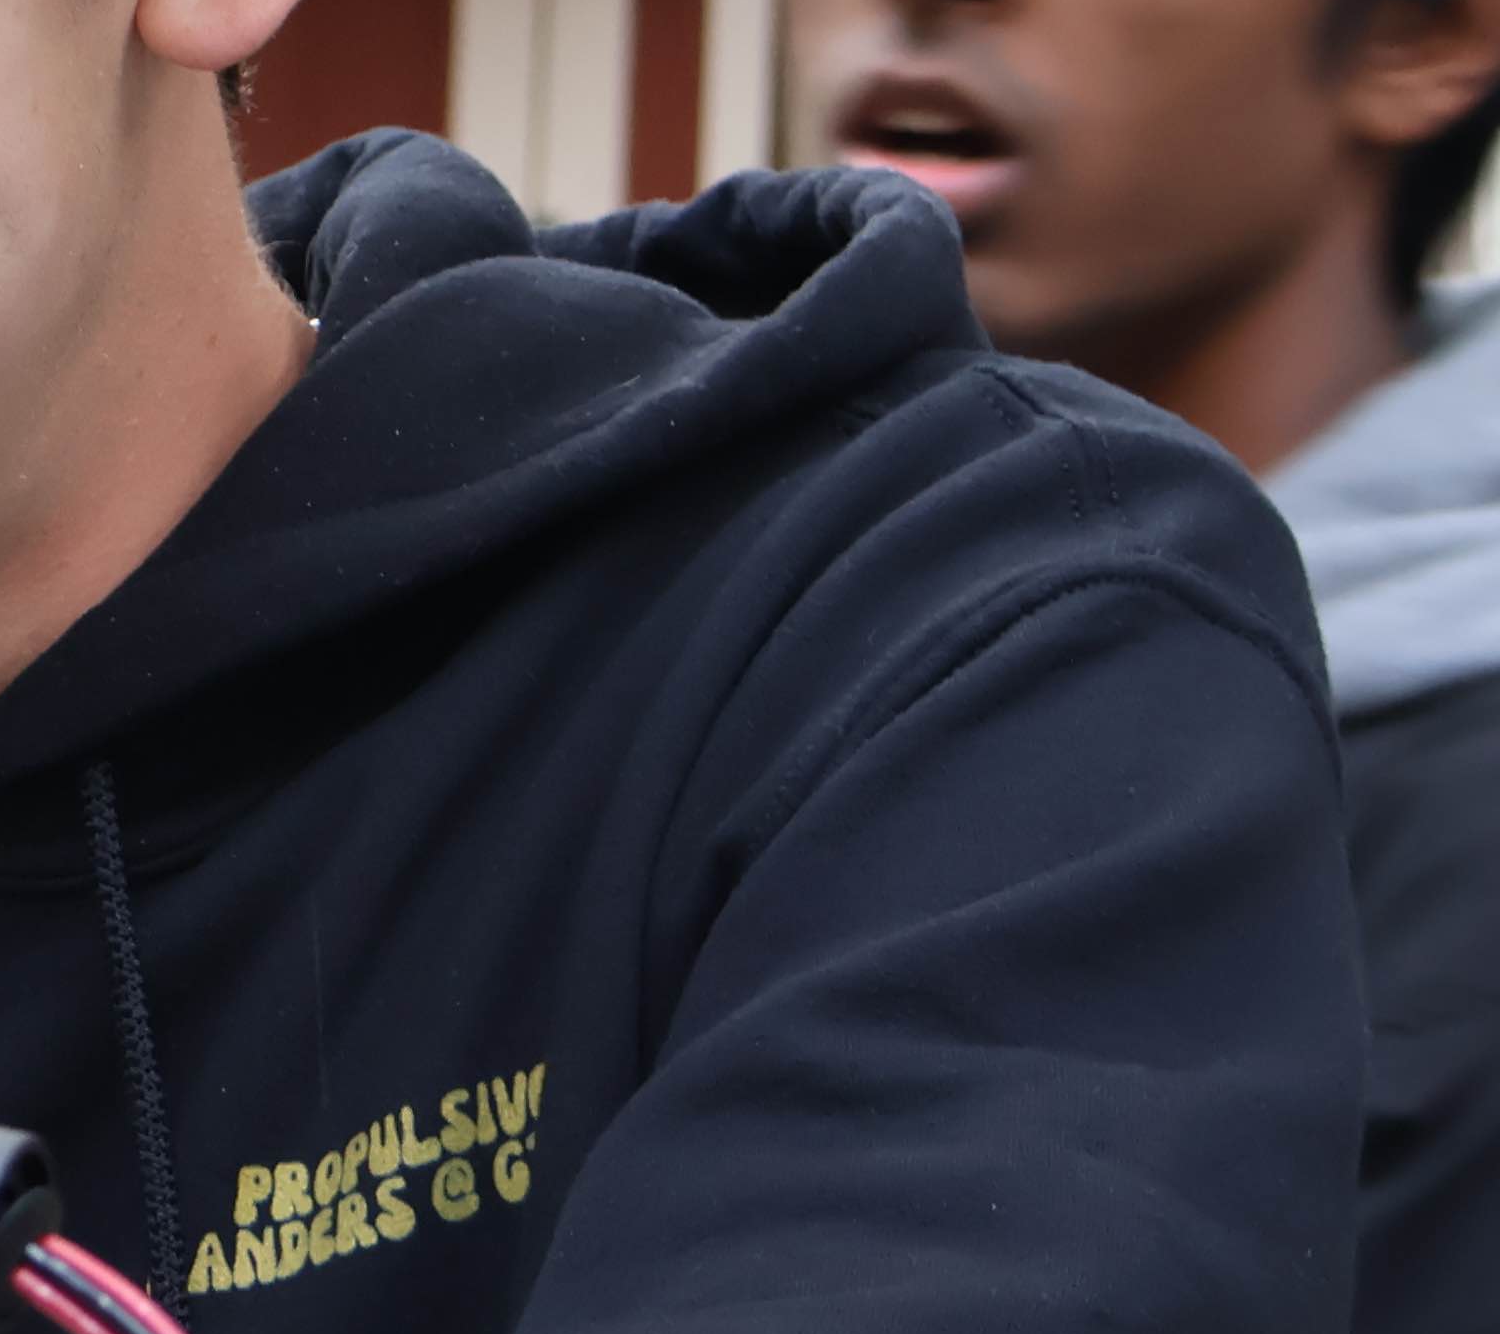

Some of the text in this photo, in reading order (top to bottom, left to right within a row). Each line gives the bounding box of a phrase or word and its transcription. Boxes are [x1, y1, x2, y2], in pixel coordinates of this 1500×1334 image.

[187, 1132, 537, 1294] ANDERS @ G
